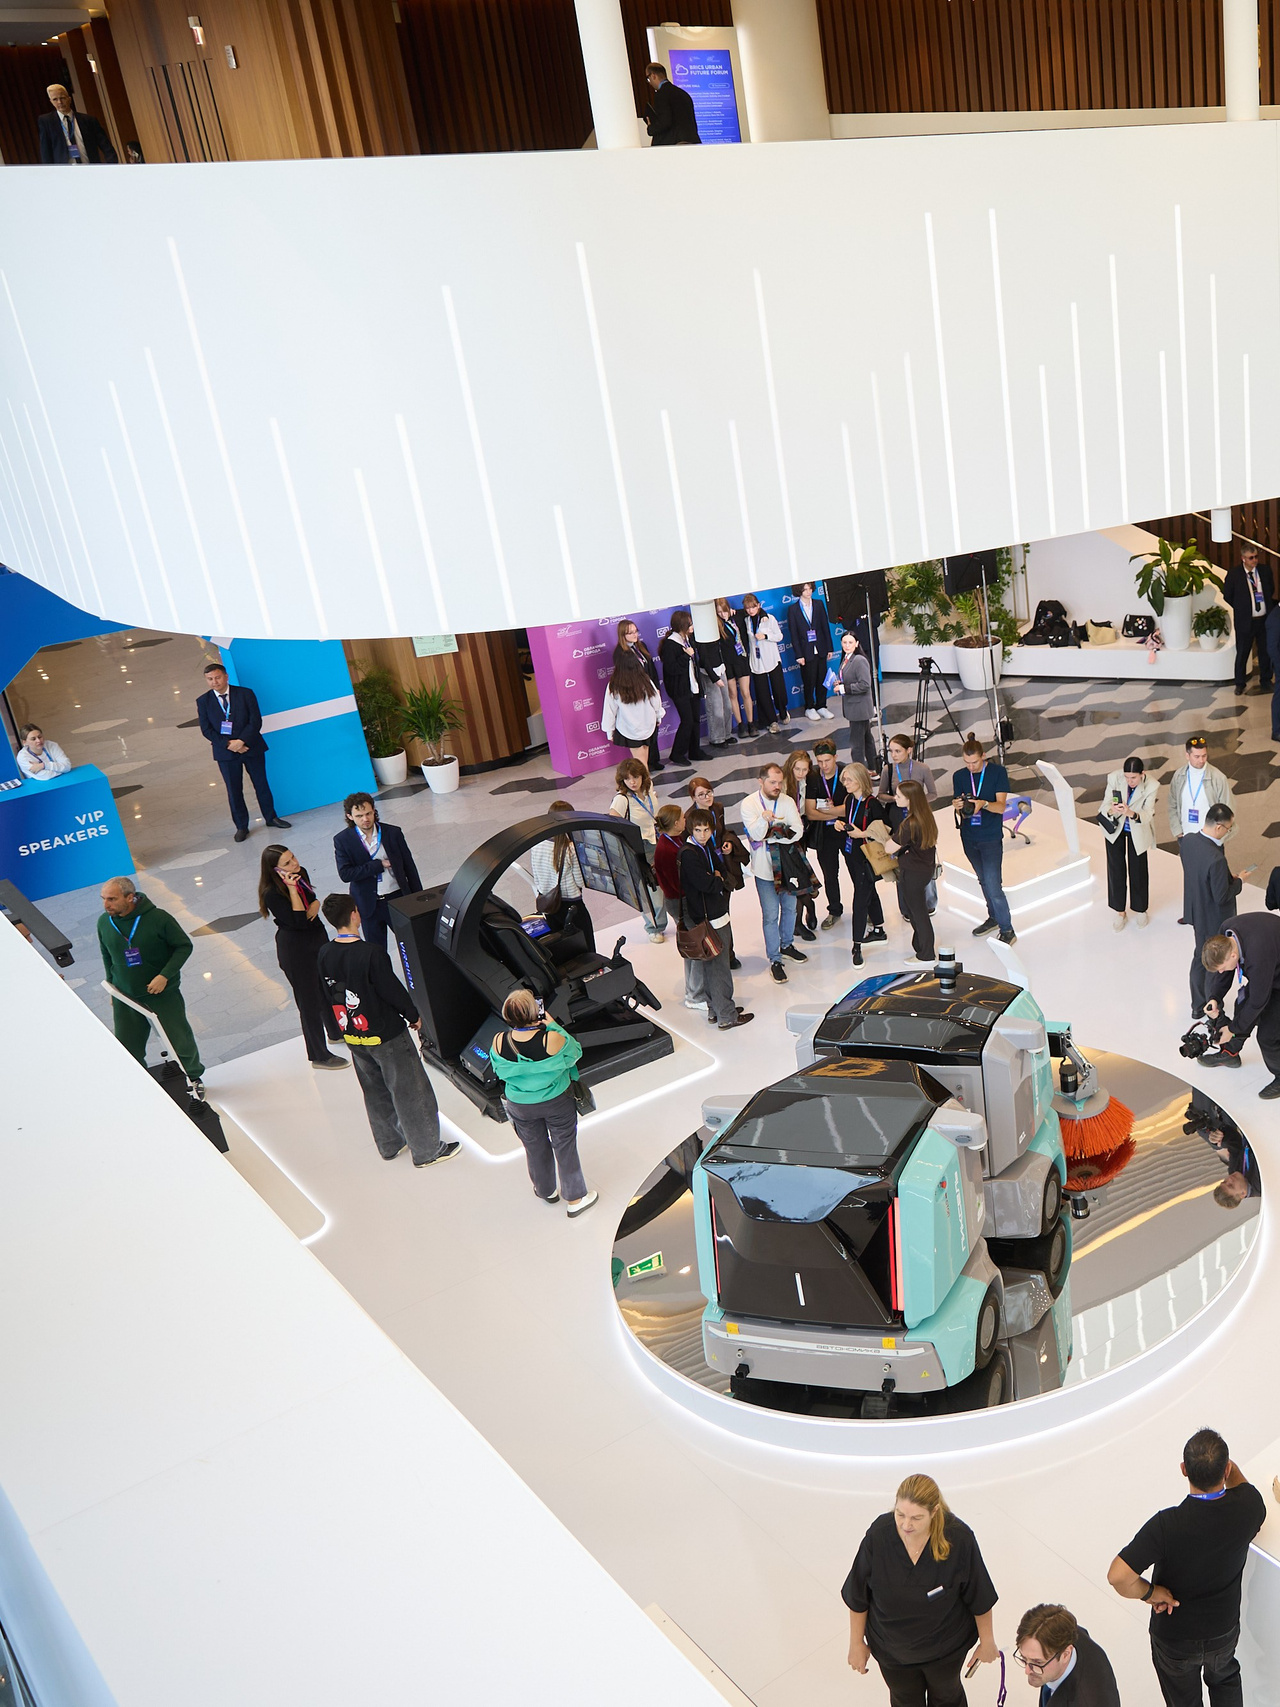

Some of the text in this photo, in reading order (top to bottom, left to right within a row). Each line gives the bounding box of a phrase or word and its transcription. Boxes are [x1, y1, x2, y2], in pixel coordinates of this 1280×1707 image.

[583, 643, 606, 651] ОБЛАЧНЫЕ
[584, 648, 601, 656] ГОРОДА
[75, 810, 104, 825] VIP
[18, 825, 109, 856] SPEAKERS
